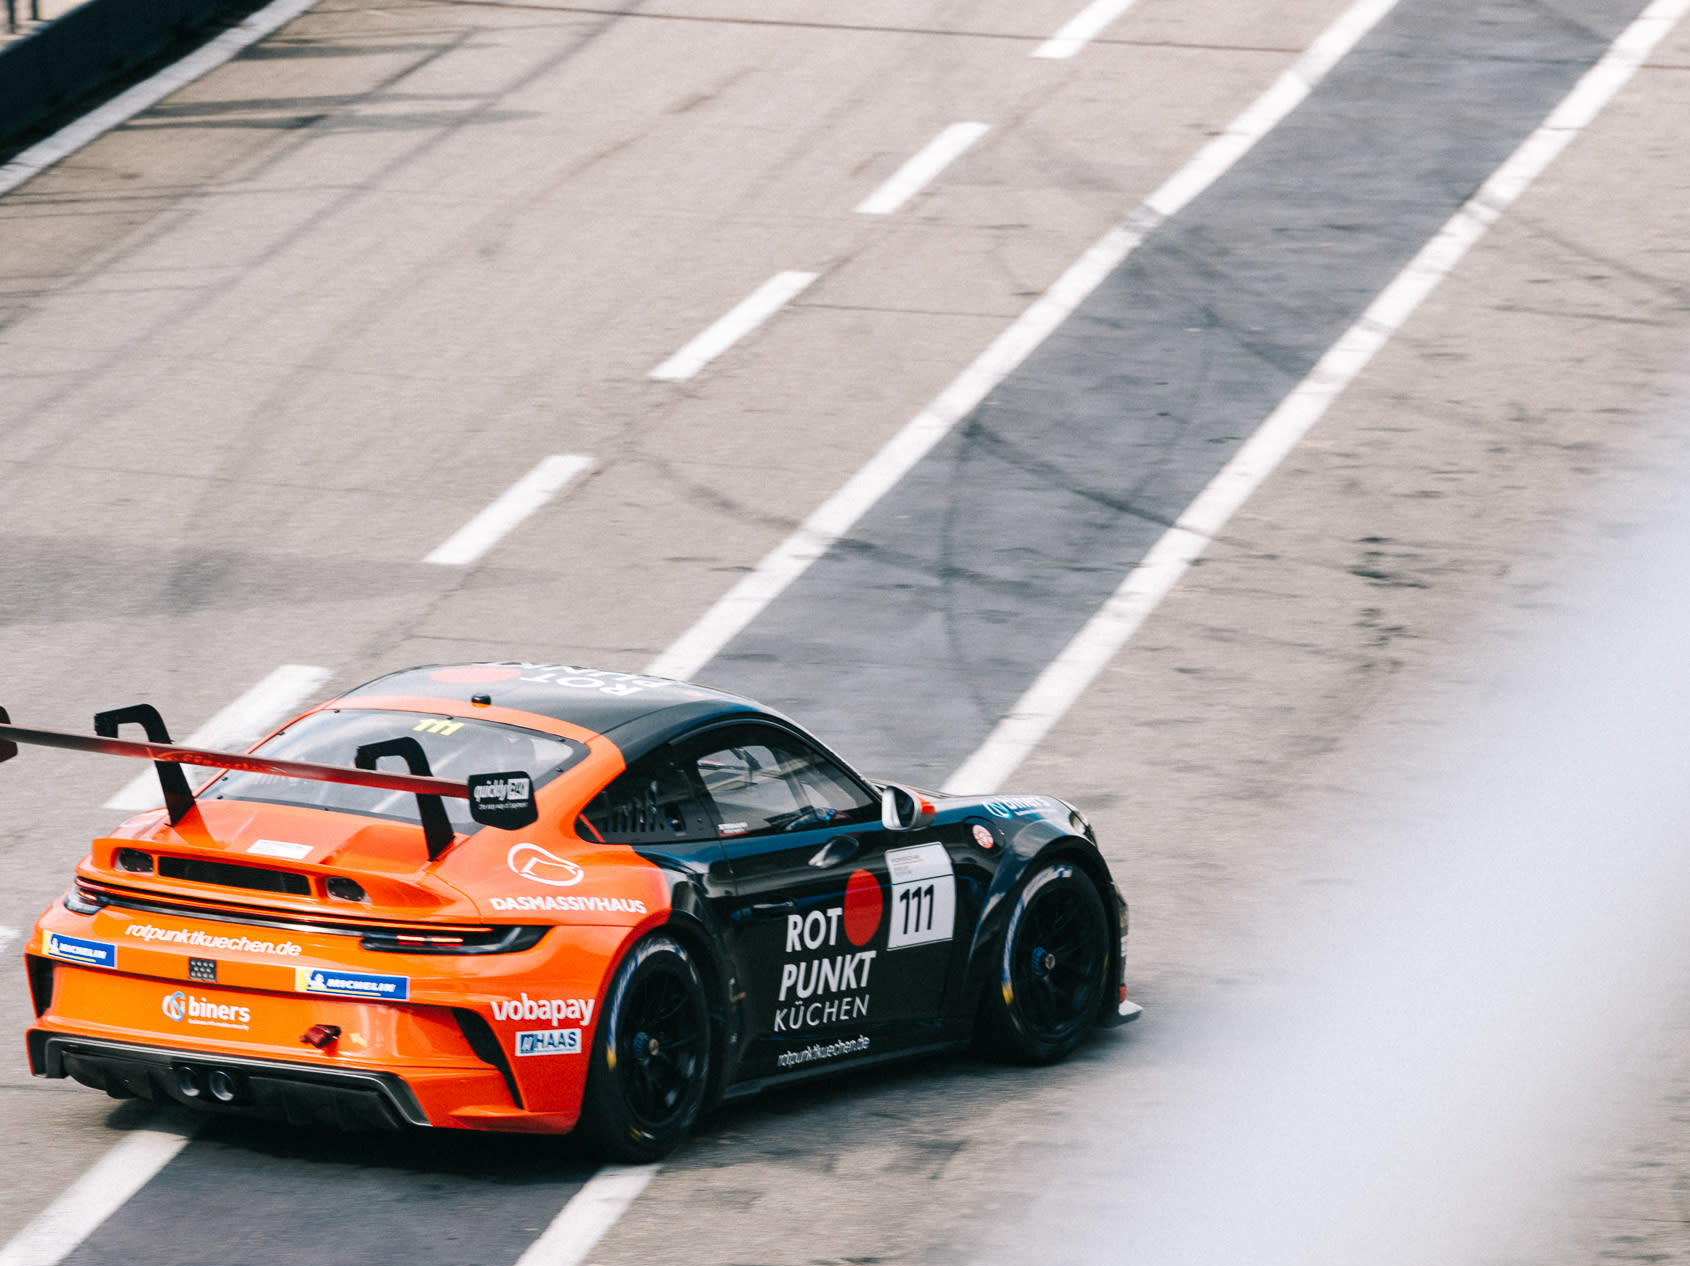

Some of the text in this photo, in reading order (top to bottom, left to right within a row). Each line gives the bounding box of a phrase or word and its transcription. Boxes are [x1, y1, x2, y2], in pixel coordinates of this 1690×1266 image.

[489, 896, 648, 914] DASMASSIVHAUS
[899, 884, 934, 935] 111
[125, 924, 302, 956] rotpunktkuechen.de
[786, 907, 842, 952] ROT
[779, 950, 877, 1001] PUNKT
[188, 996, 251, 1022] biners
[490, 992, 595, 1027] vobapay
[773, 994, 870, 1032] KÜCHEN
[534, 1031, 577, 1049] HAAS
